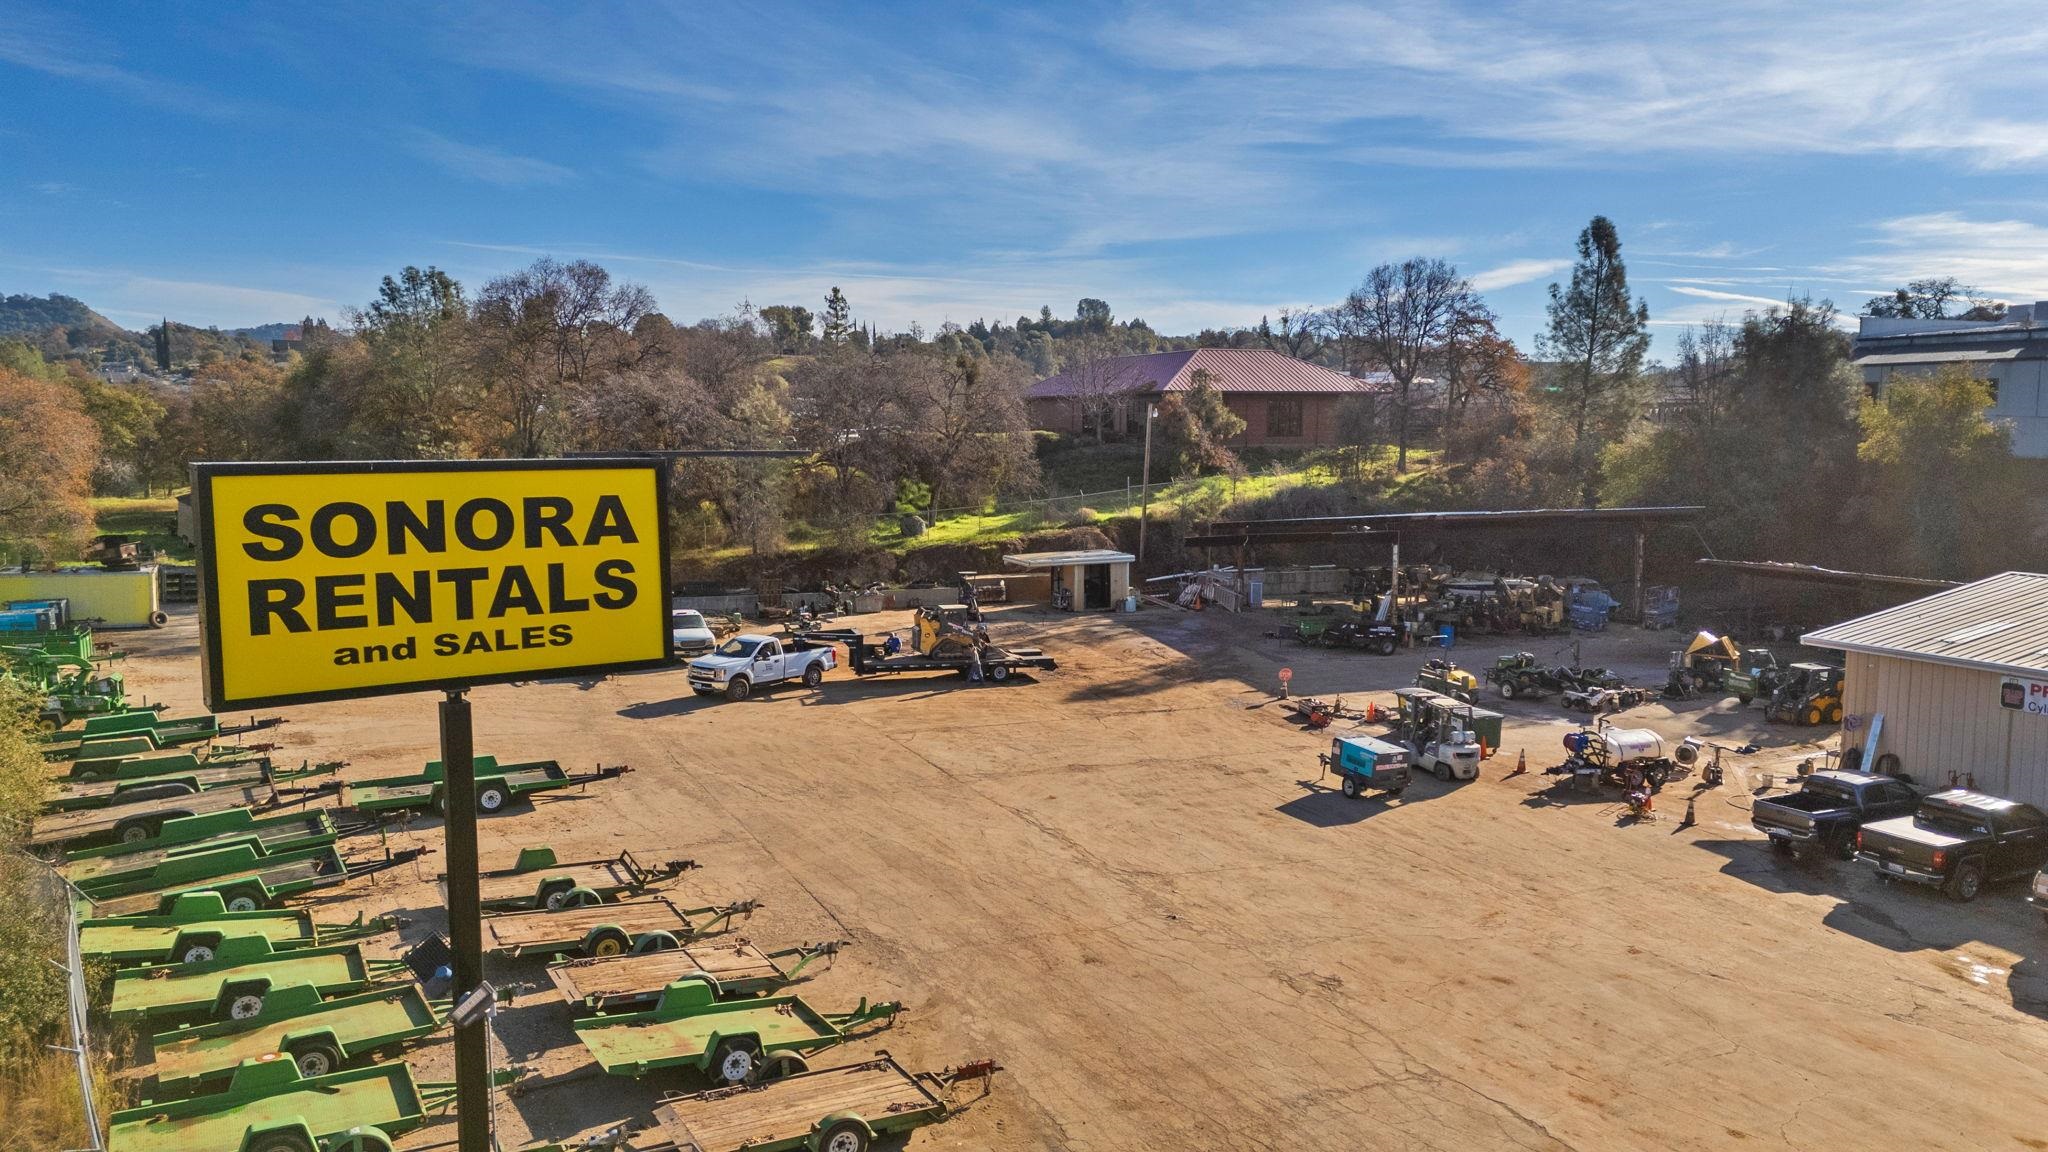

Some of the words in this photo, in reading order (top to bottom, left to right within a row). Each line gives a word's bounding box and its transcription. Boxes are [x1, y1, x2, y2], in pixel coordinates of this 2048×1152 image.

[242, 495, 639, 561] SONORA
[248, 559, 638, 636] RENTALS
[334, 637, 416, 665] and
[434, 624, 573, 656] SALES
